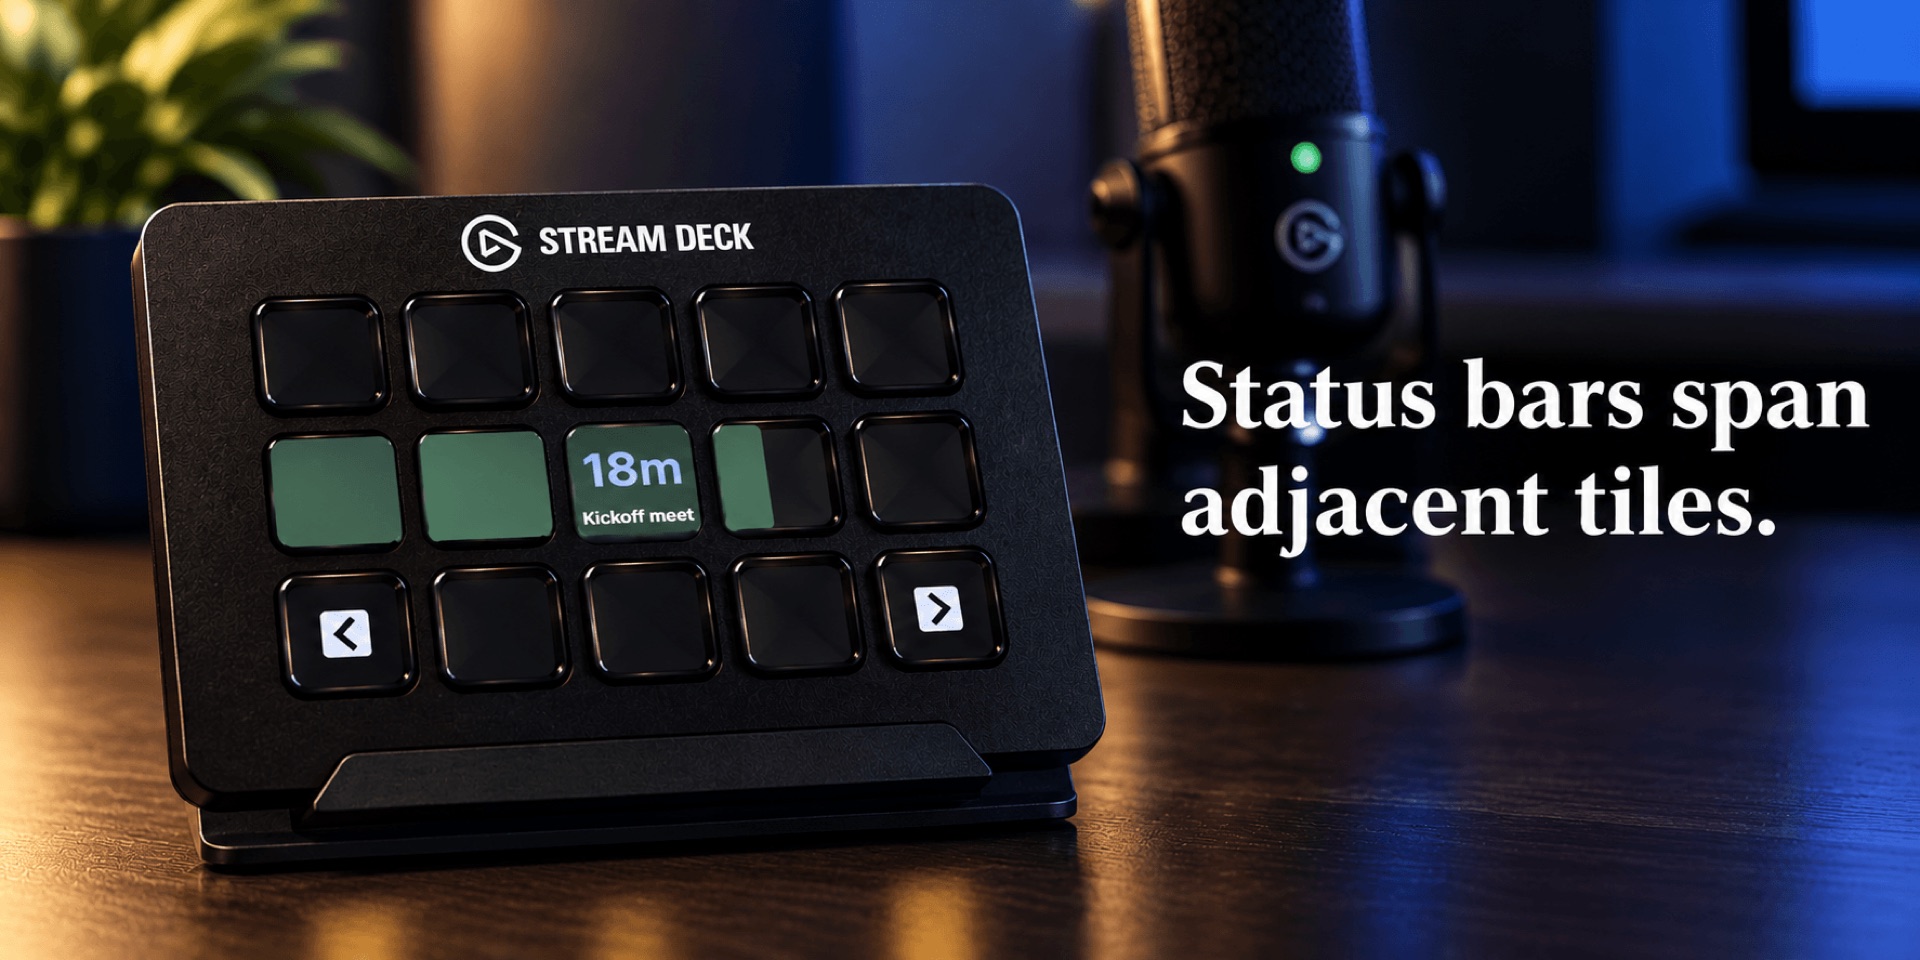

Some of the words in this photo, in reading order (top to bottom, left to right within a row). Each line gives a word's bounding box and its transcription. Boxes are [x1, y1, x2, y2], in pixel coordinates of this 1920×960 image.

[539, 224, 667, 255] STREAM
[675, 222, 755, 252] DECK
[582, 451, 682, 487] 18m
[582, 509, 645, 526] Kickoff
[649, 508, 695, 523] meet
